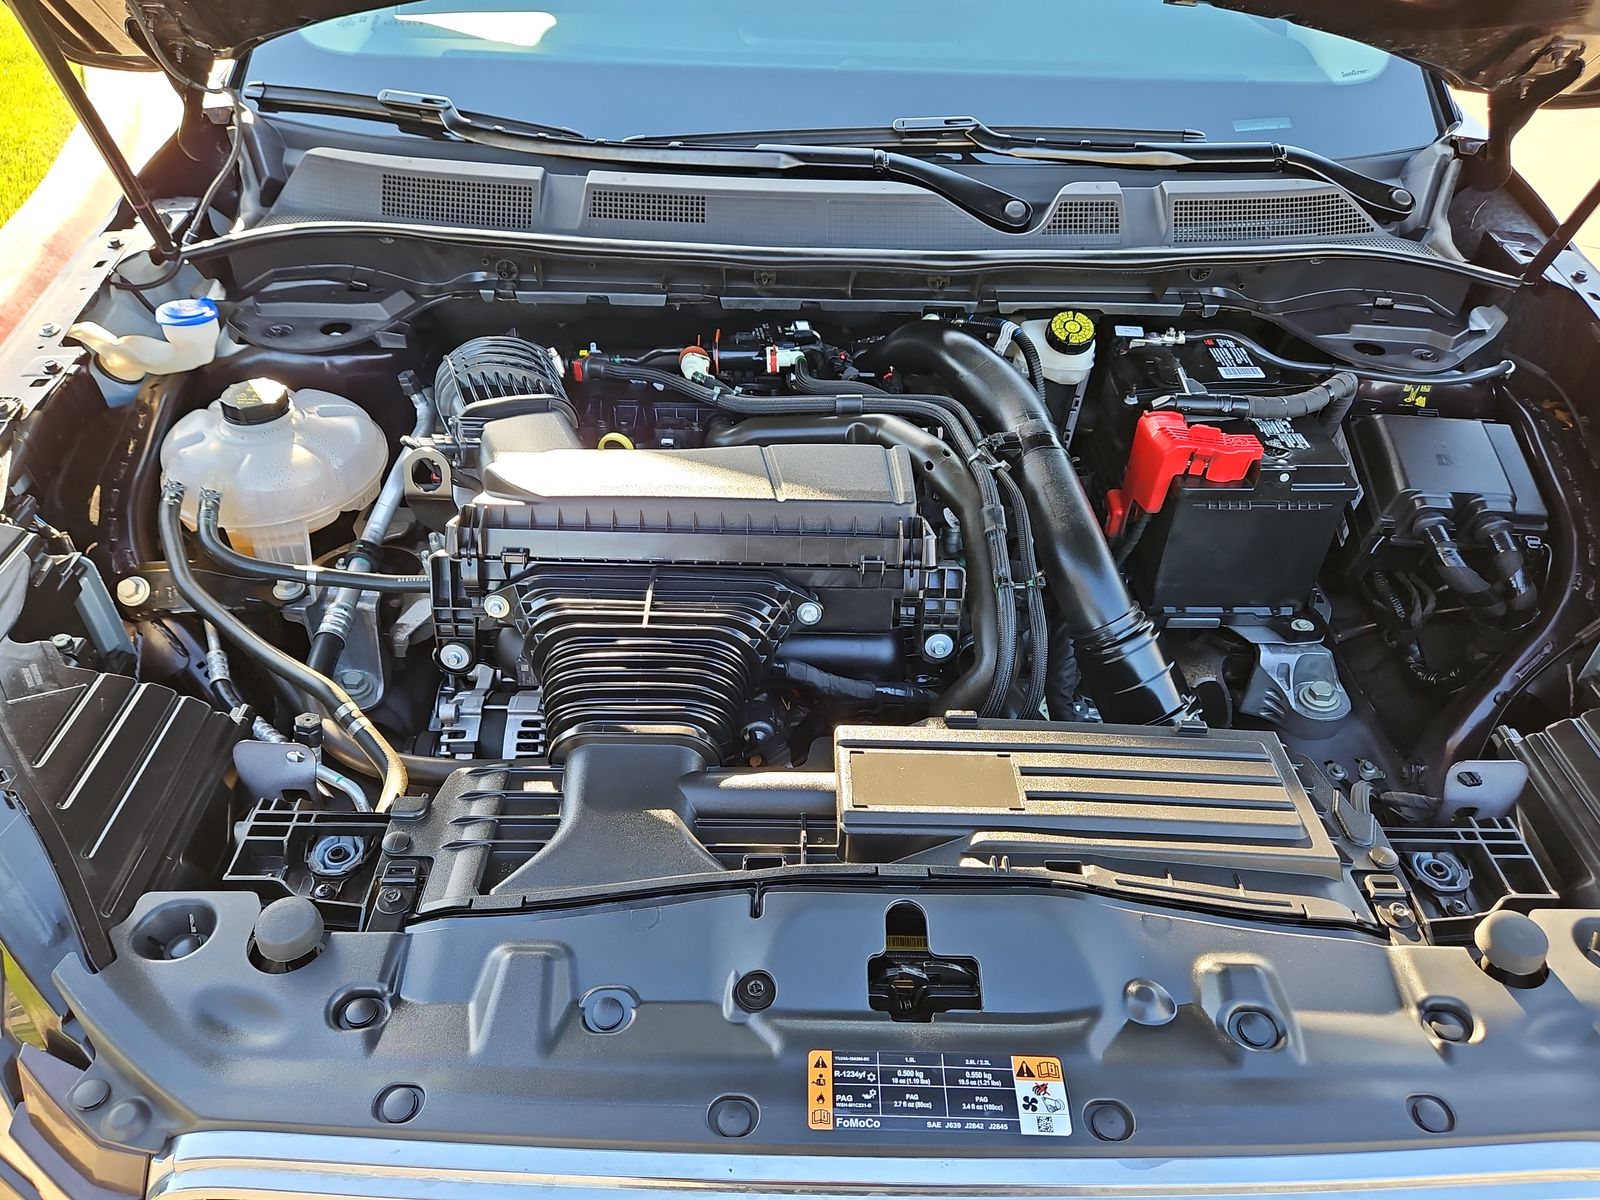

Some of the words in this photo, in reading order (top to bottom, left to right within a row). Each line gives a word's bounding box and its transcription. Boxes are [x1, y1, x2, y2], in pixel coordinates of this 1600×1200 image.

[834, 1070, 866, 1079] R-1234yf
[897, 1069, 914, 1077] 0.500
[915, 1070, 924, 1078] kg
[983, 1072, 992, 1080] kg
[835, 1094, 853, 1102] PAG
[836, 1117, 881, 1129] FoMoCo
[945, 1121, 962, 1129] J639
[988, 1123, 1008, 1131] J2845
